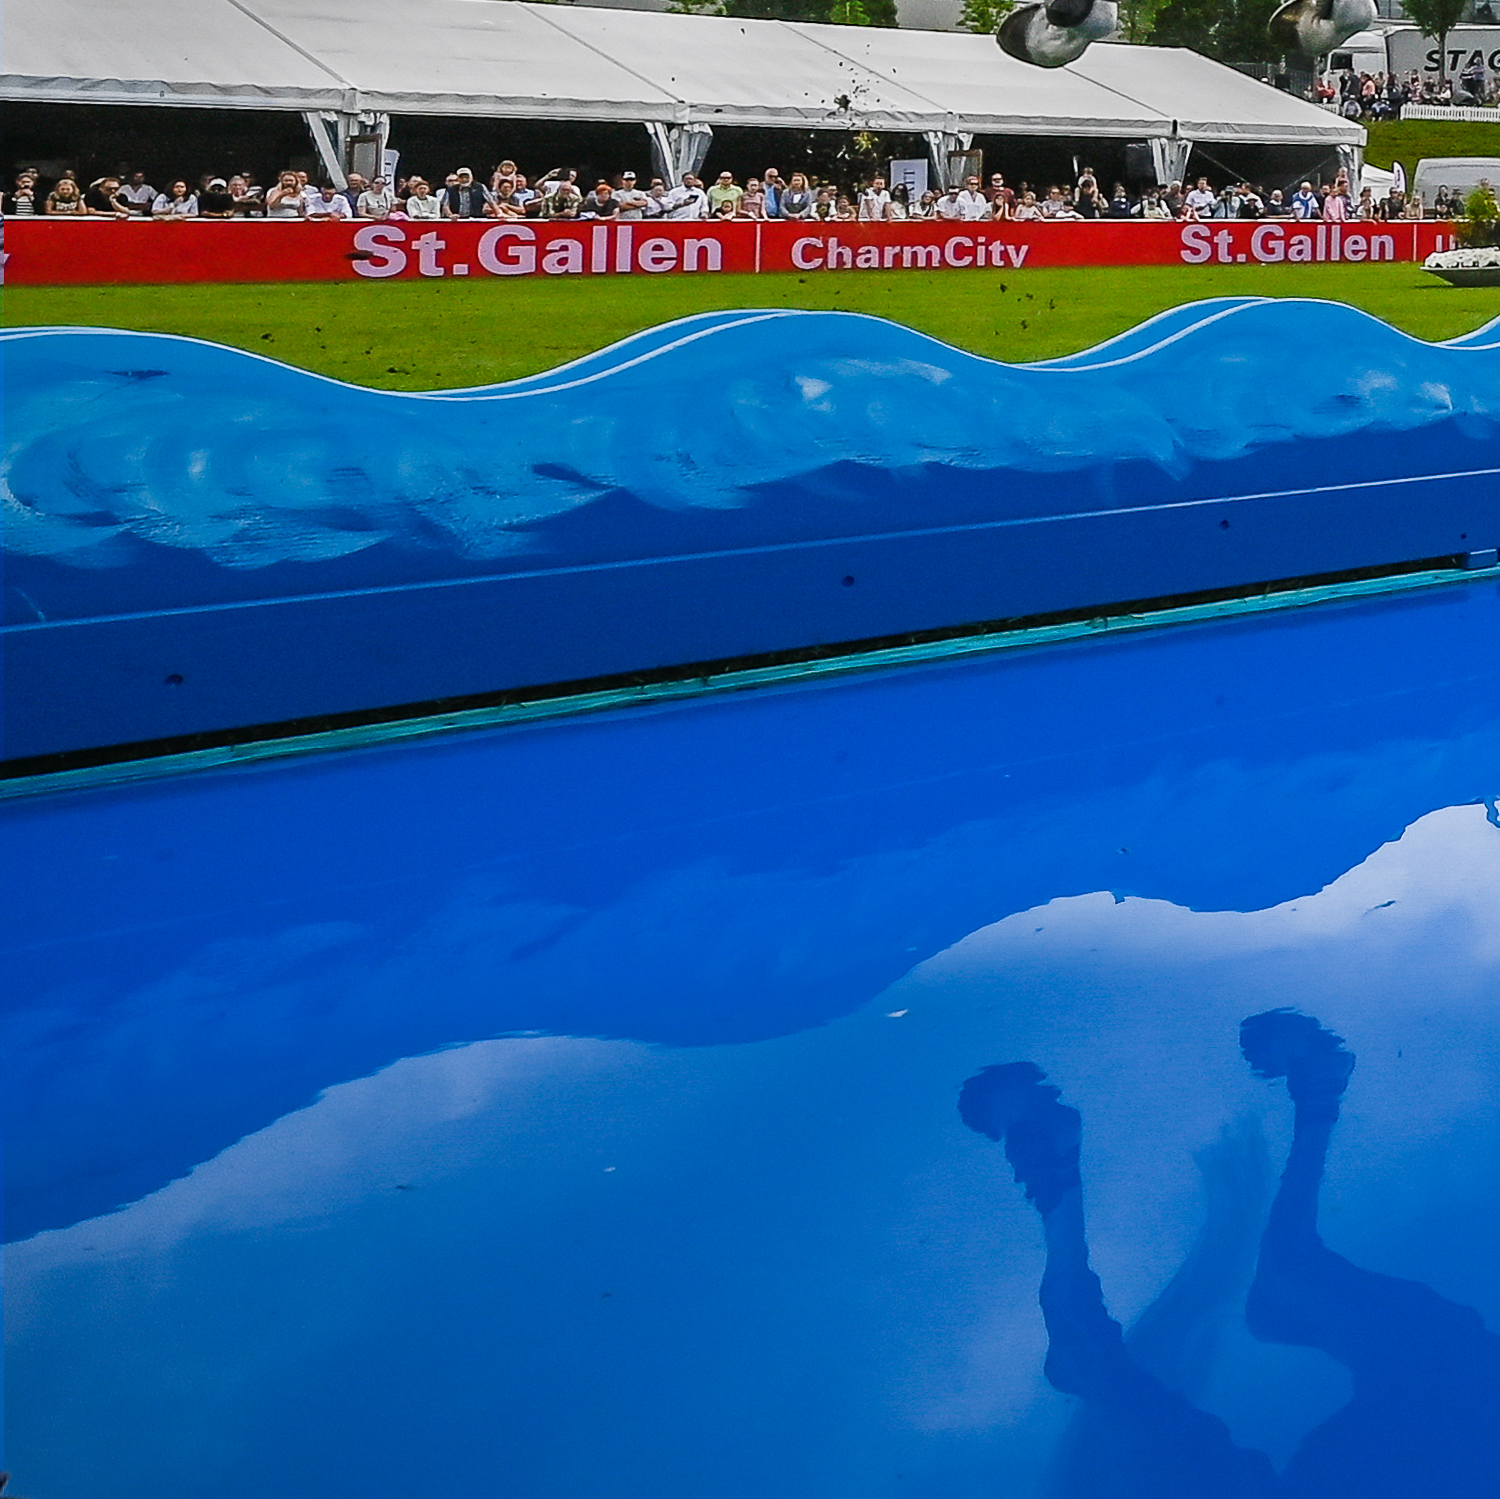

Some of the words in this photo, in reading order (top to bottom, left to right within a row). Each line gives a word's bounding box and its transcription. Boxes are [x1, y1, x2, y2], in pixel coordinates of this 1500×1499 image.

[351, 224, 722, 278] St.Gallen
[791, 236, 1029, 270] CharmCity
[1180, 224, 1395, 264] St.Gallen
